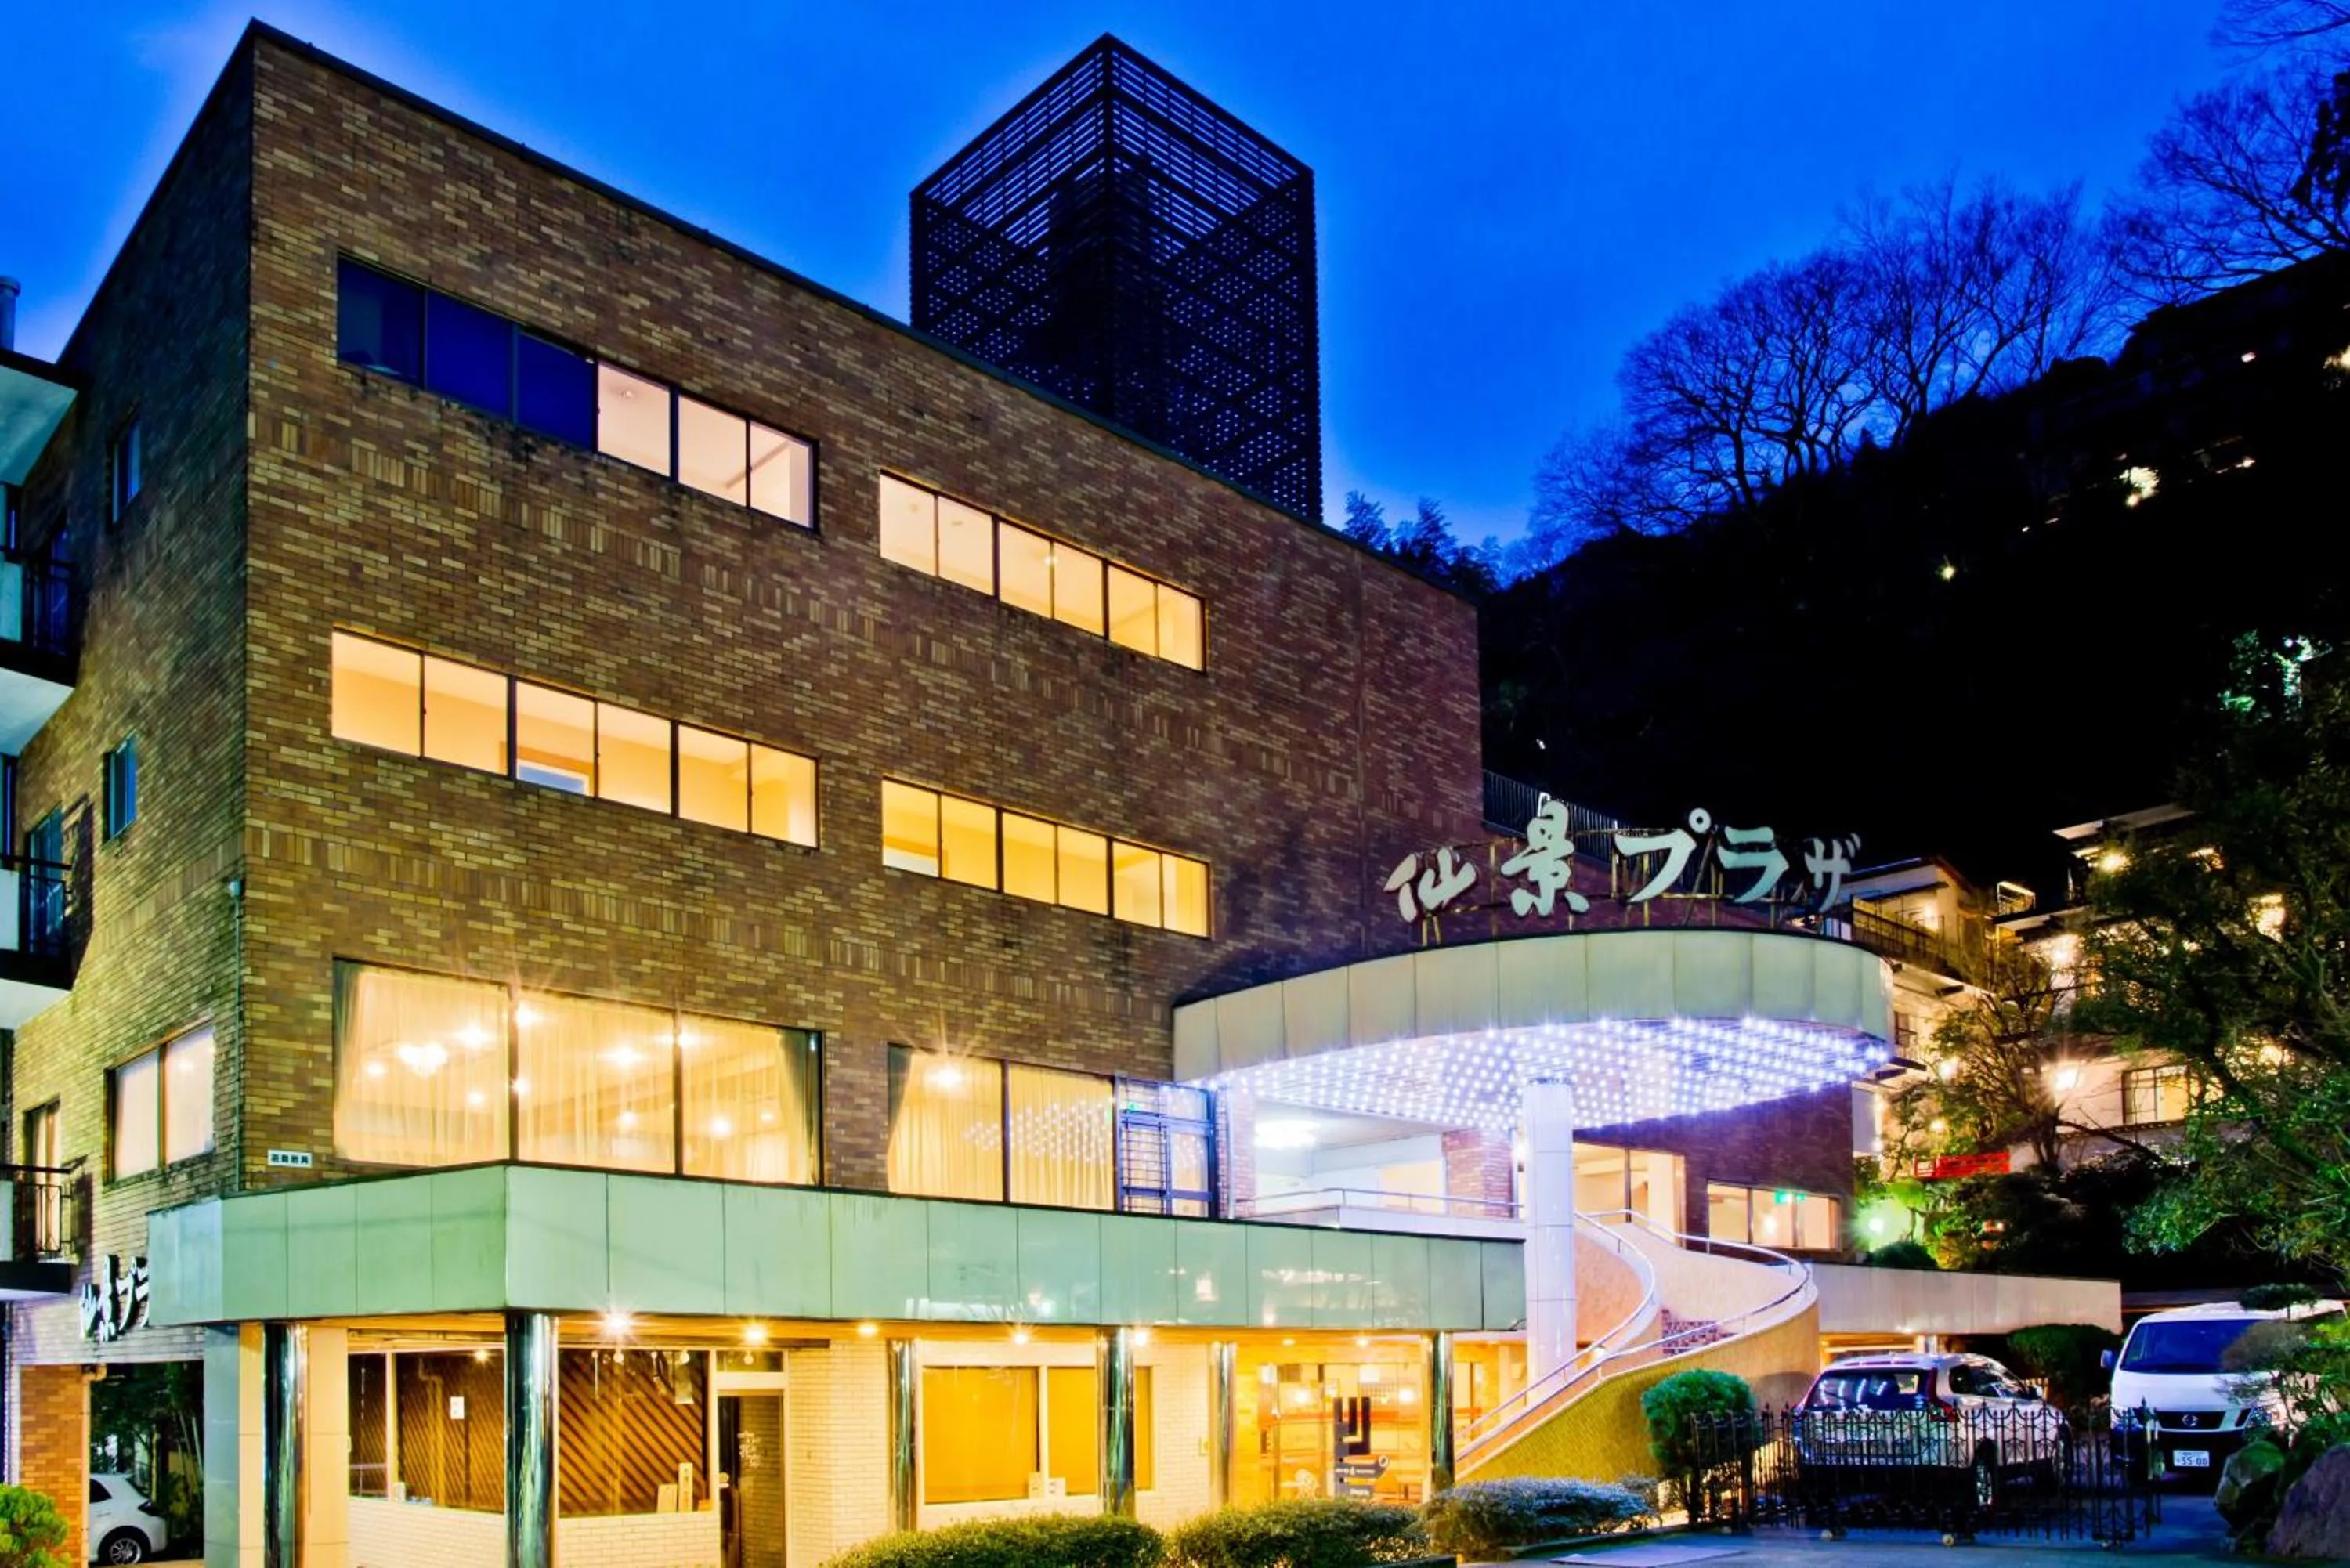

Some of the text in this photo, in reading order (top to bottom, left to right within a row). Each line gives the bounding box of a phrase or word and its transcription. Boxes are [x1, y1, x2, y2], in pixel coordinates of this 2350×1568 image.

[1384, 800, 1860, 922] 仙景プラザ
